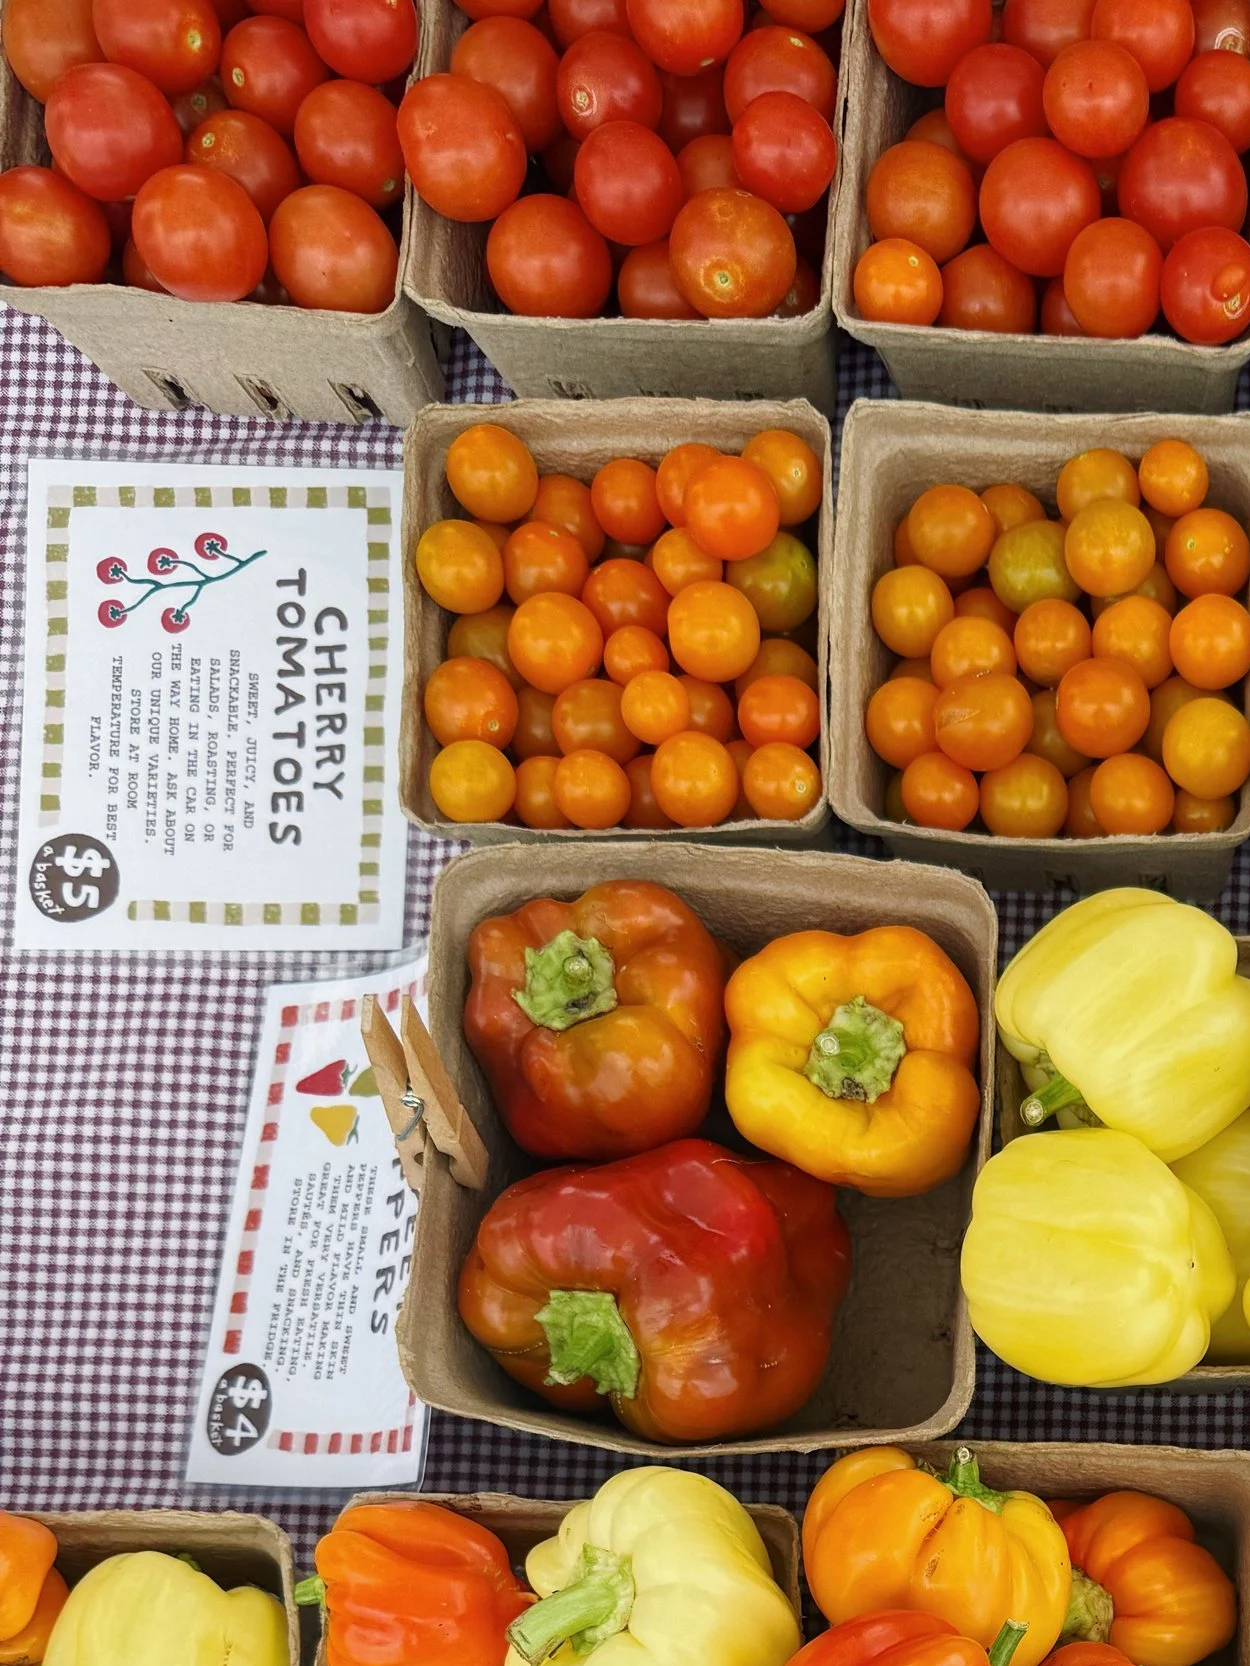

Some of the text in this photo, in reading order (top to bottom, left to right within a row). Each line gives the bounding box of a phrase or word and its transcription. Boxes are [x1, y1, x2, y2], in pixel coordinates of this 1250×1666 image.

[88, 716, 101, 778] FLAVOR.
[106, 655, 123, 841] TEMPERATURE FOR BEST
[127, 689, 141, 810] STORE AT ROOM
[145, 652, 162, 844] OUR UNIQUE VARIETIES.
[165, 643, 182, 856] THE WAY HOME. ASK ABOUT
[184, 658, 201, 842] EATING IN THE CAR ON
[204, 658, 220, 842] SALADS, ROASTING, OR
[223, 649, 240, 852] SNACKABLE. PERFECT FOR
[243, 673, 259, 829] SWEET, JUICY, AND
[268, 567, 308, 846] TOMATOES
[313, 607, 348, 800] CHERRY
[33, 846, 65, 914] a basket
[55, 845, 110, 908] $5
[262, 1178, 303, 1367] STORE IN THE FRIDGE.
[275, 1288, 297, 1372] SNACKING.
[287, 1162, 331, 1381] GREAT FOR FRESH EATING,
[291, 1249, 303, 1278] AND
[302, 1175, 342, 1367] THEM VERY VERSATILE.
[314, 1164, 355, 1380] AND MILD FLAVOR MAKING
[326, 1163, 367, 1380] PEPPERS HAVE THIN SKIN
[340, 1165, 378, 1375] THESE SMALL AND SWEET
[371, 1158, 405, 1335] PERS
[210, 1378, 228, 1446] a basket
[225, 1375, 268, 1447] $4
